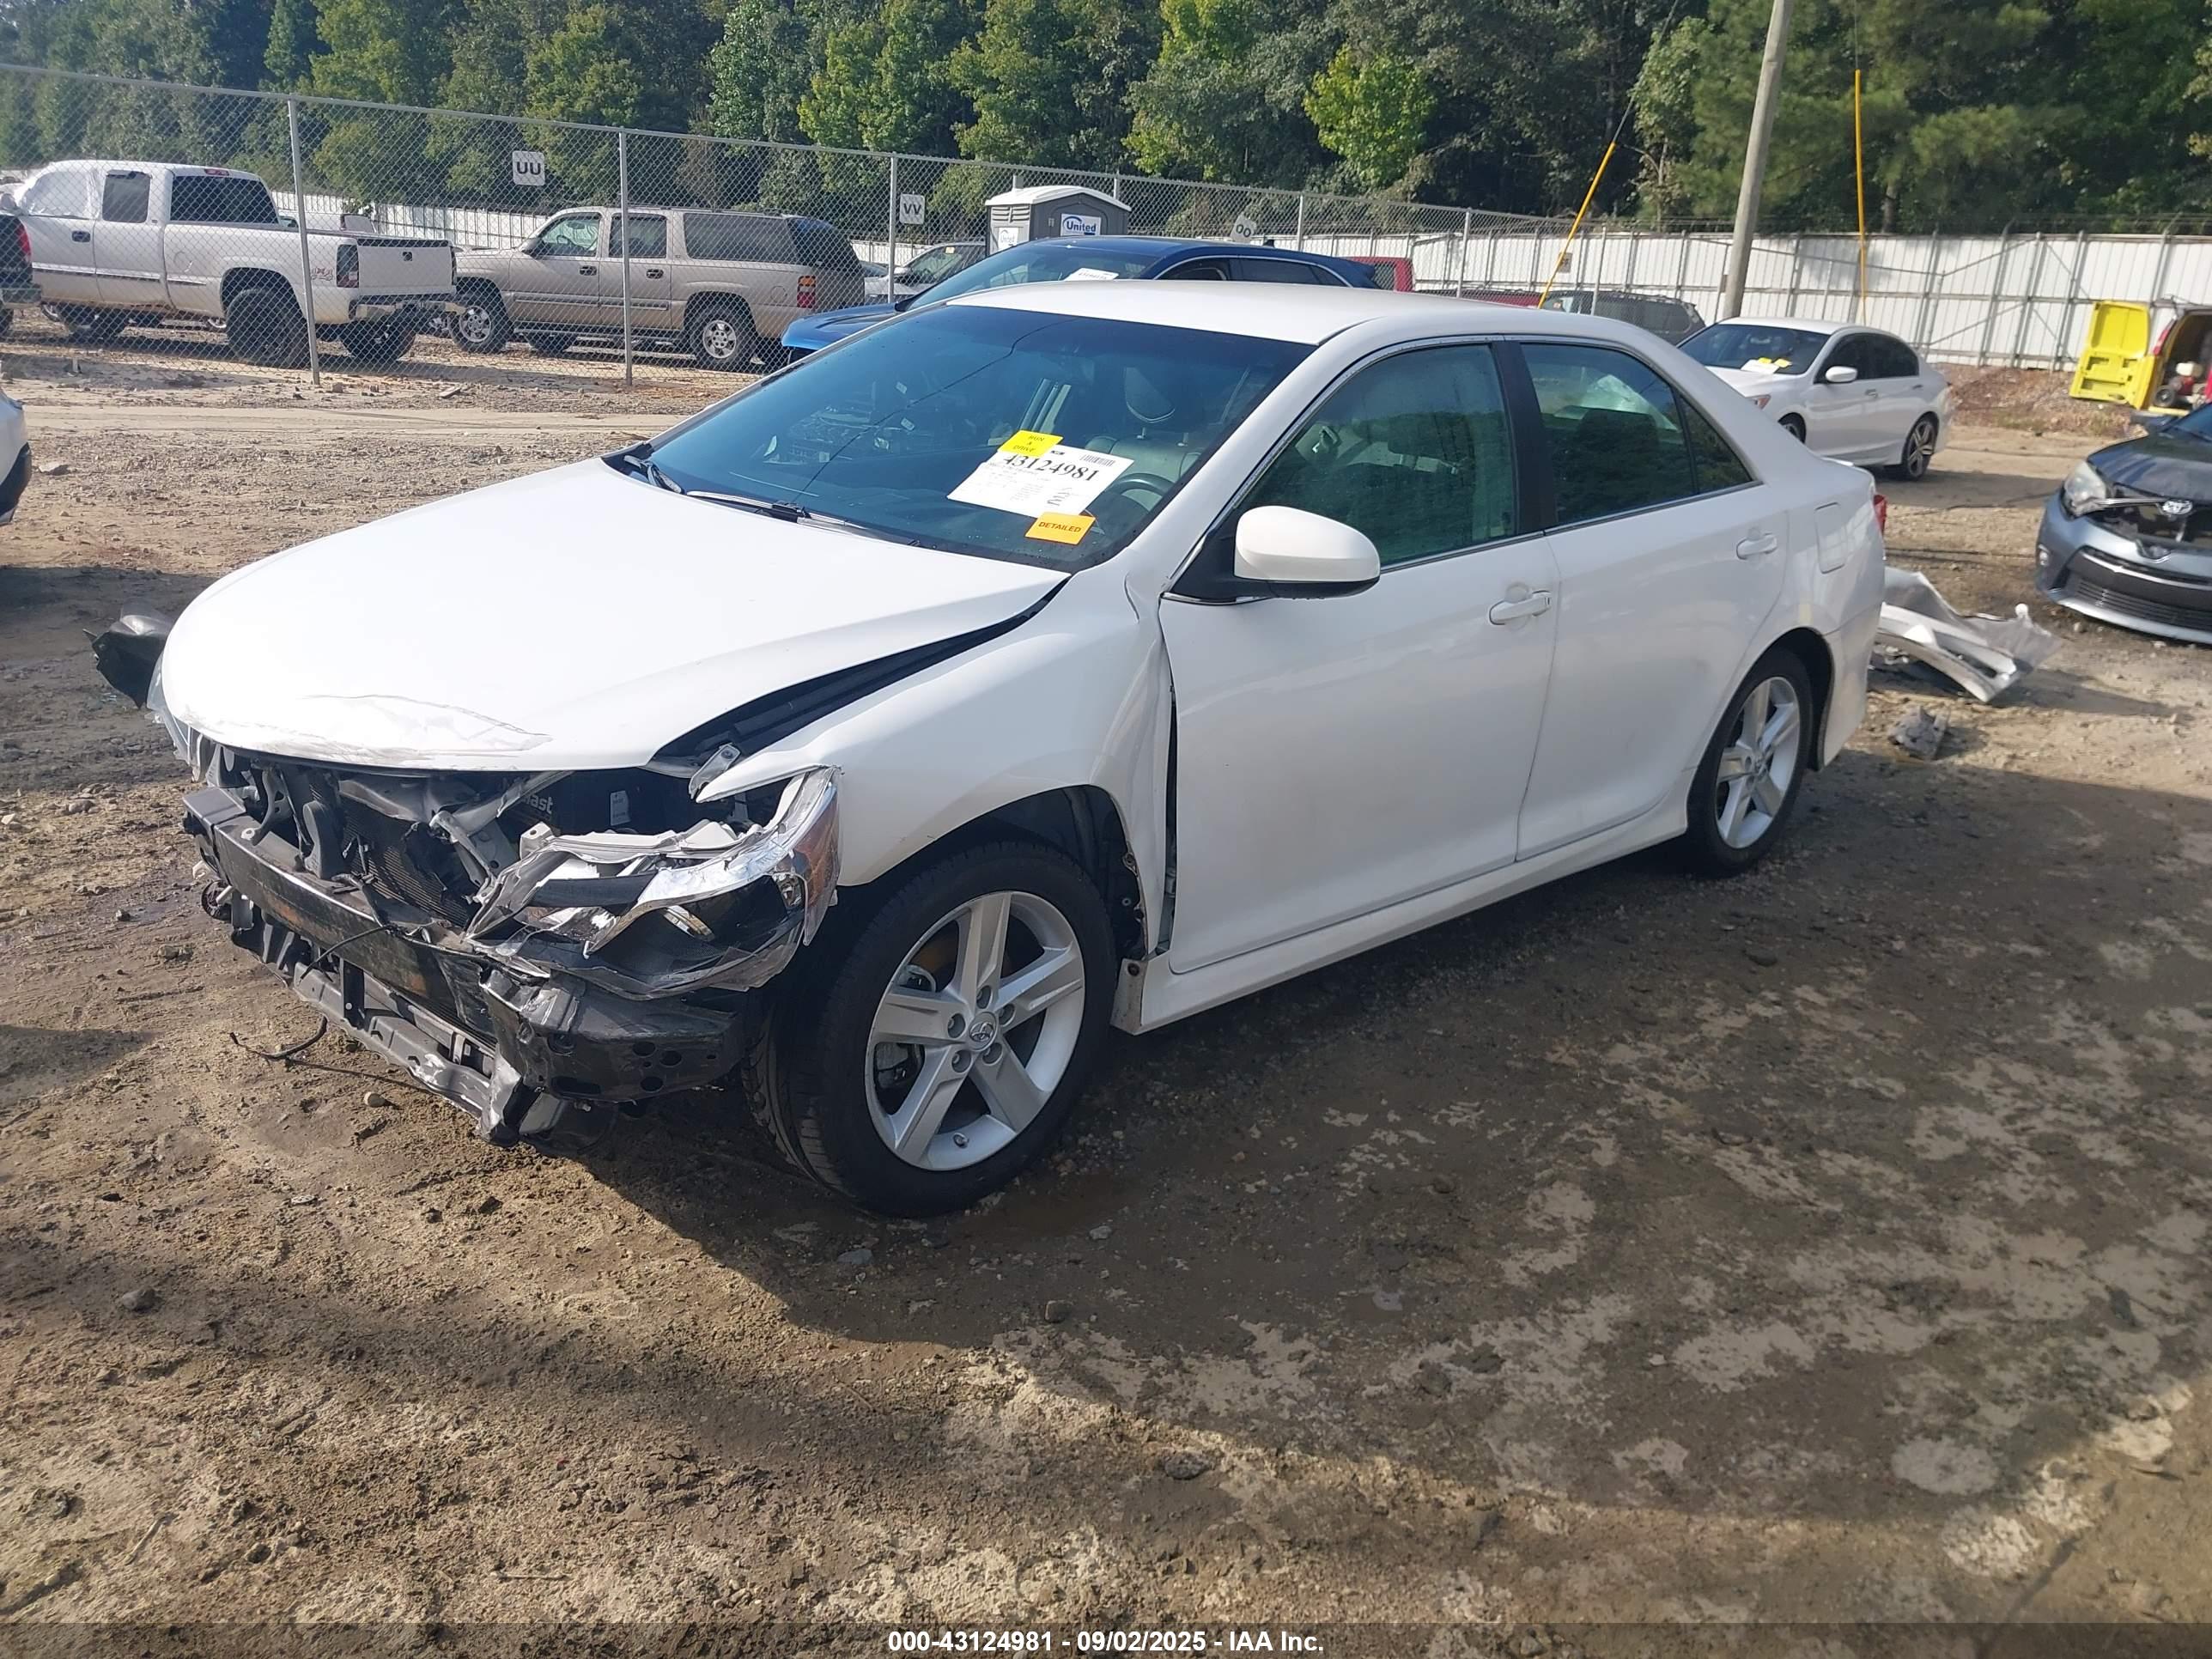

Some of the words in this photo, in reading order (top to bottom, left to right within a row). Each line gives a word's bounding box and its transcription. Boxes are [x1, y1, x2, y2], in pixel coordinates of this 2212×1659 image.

[516, 161, 541, 175] UU
[903, 203, 921, 215] VV
[1066, 221, 1097, 233] United
[1003, 453, 1100, 481] 43124981
[1038, 521, 1082, 532] DETAILED
